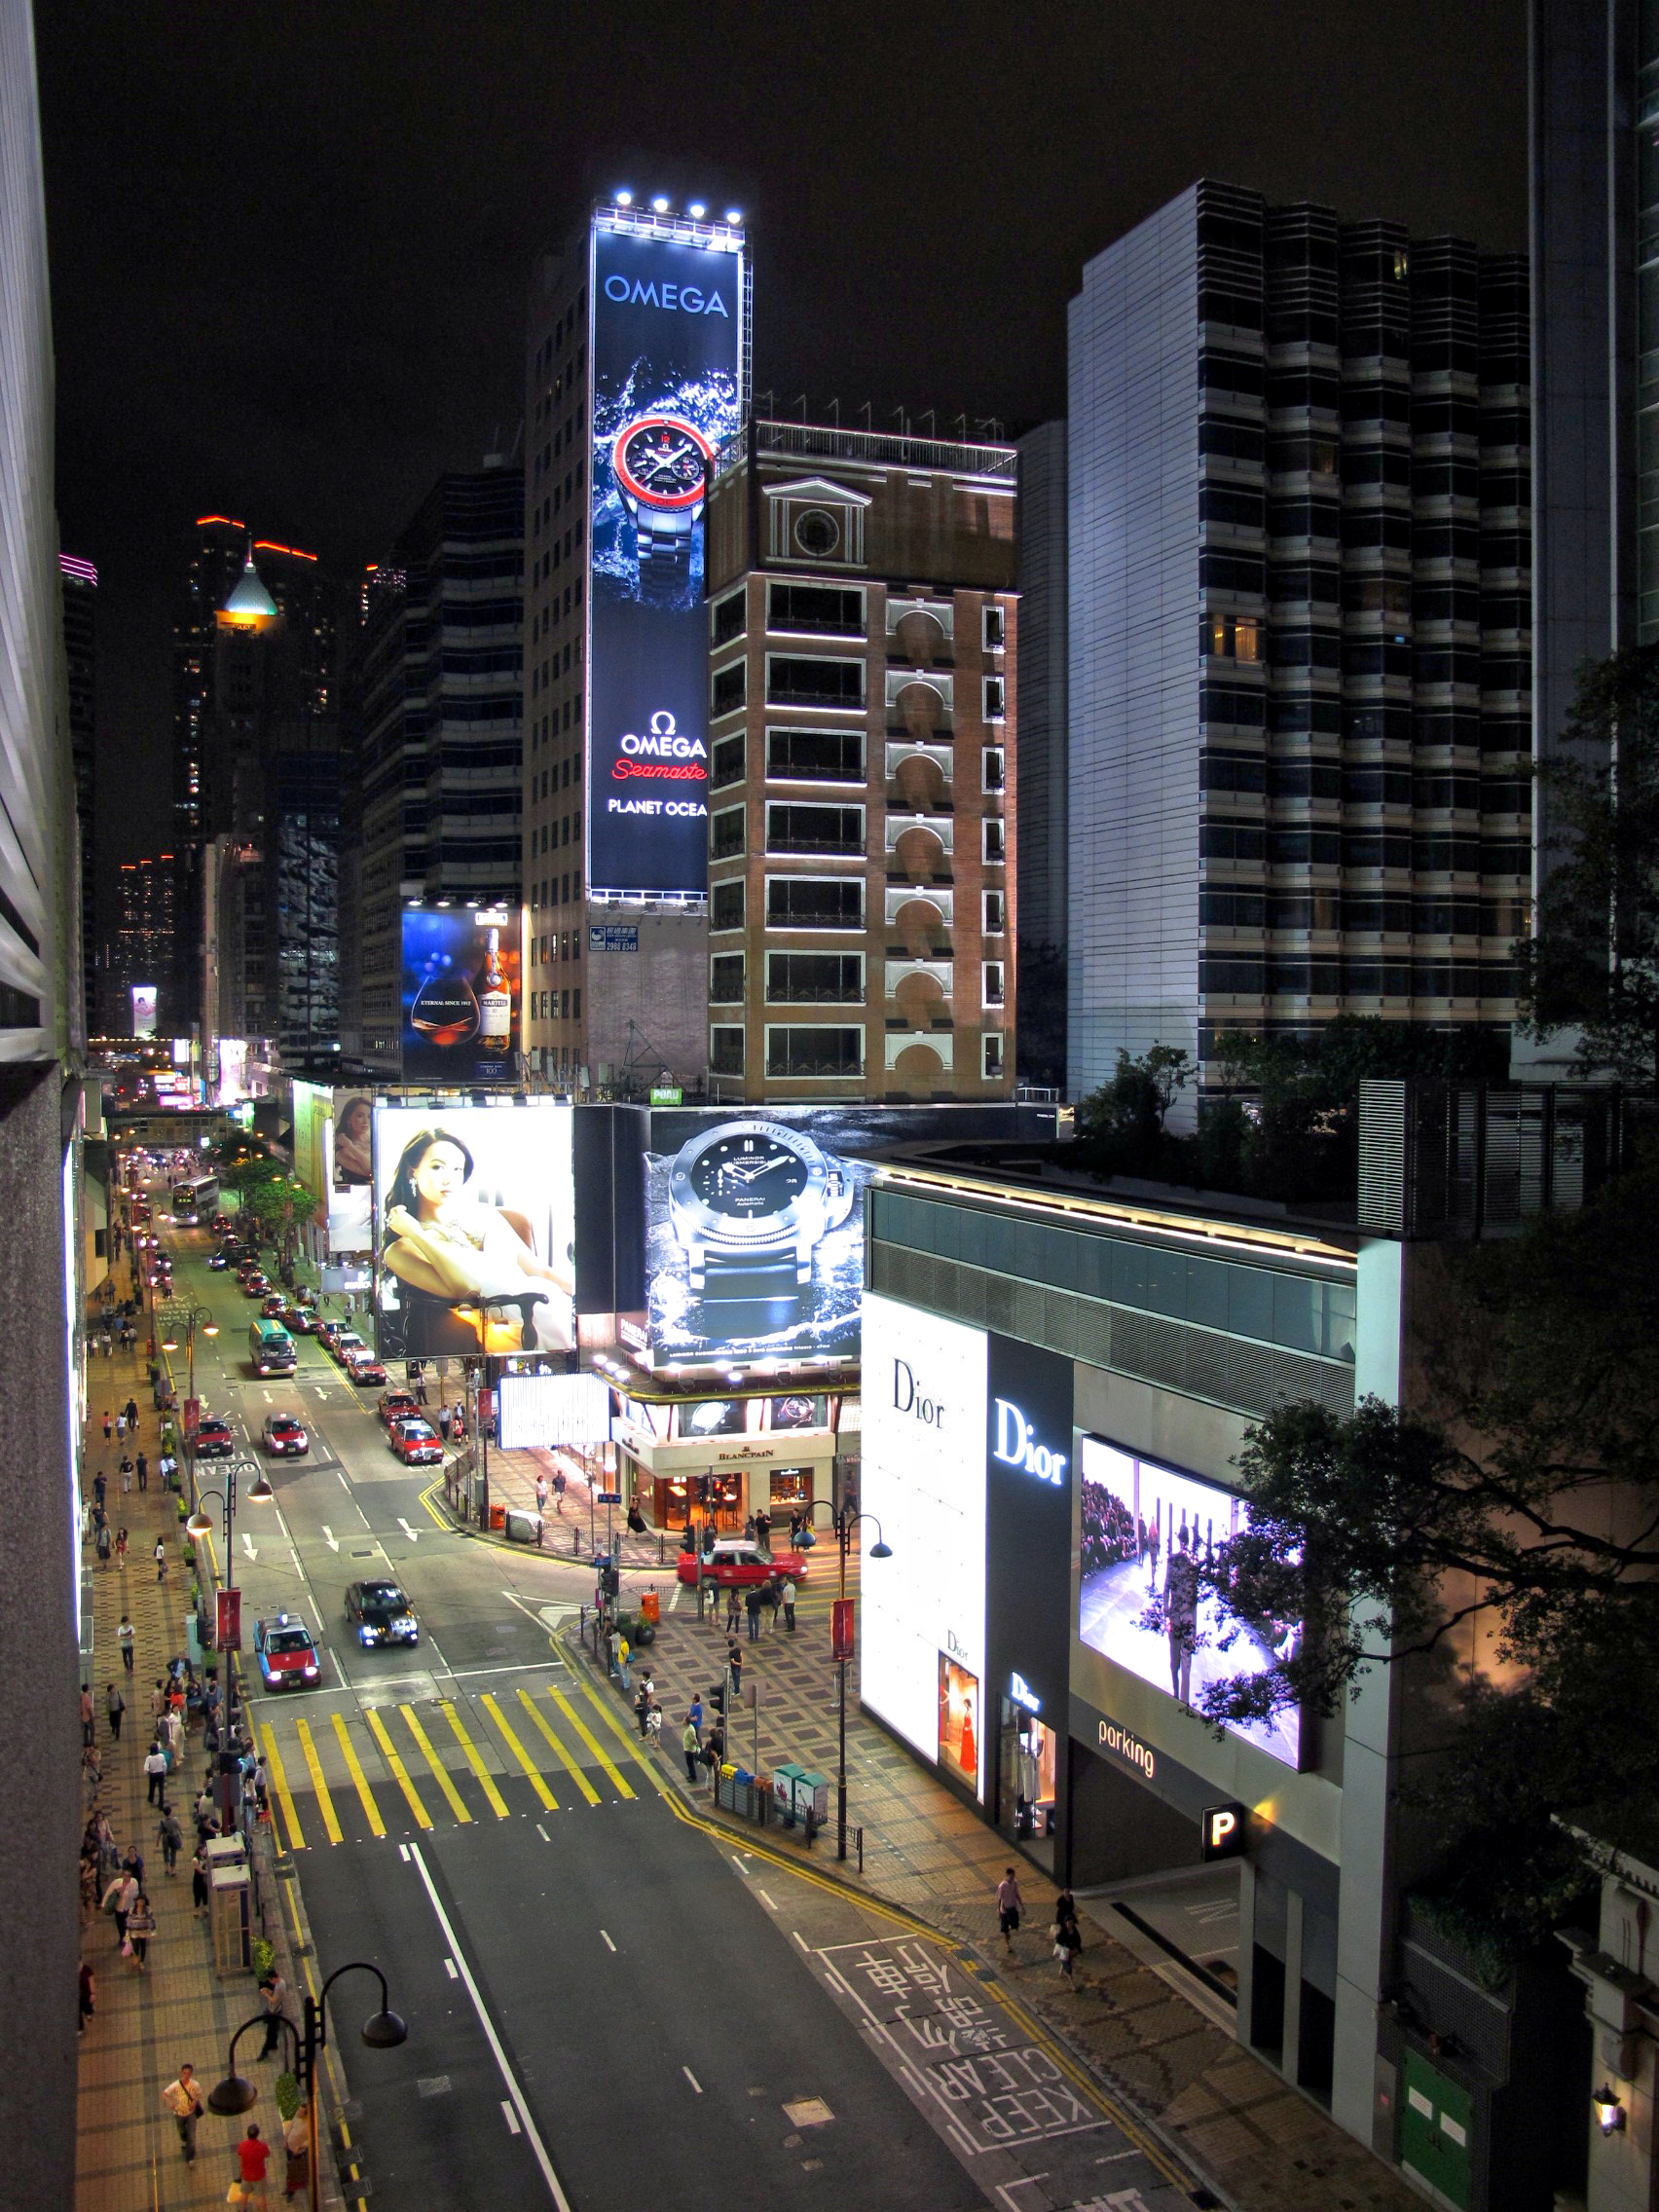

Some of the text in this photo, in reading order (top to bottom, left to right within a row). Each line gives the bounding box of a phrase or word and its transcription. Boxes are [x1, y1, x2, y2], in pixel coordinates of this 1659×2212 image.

[605, 276, 728, 317] OMEGA
[621, 735, 707, 757] OMEGA
[608, 798, 662, 815] PLANET
[892, 1358, 945, 1429] Dior
[719, 1450, 775, 1460] BLANCPAIN
[993, 1397, 1067, 1486] Dior
[947, 1629, 970, 1662] Dior
[1098, 1719, 1155, 1779] parking
[1212, 1811, 1235, 1847] P
[925, 2047, 1064, 2102] CLEAR
[980, 2084, 1093, 2139] KEEP
